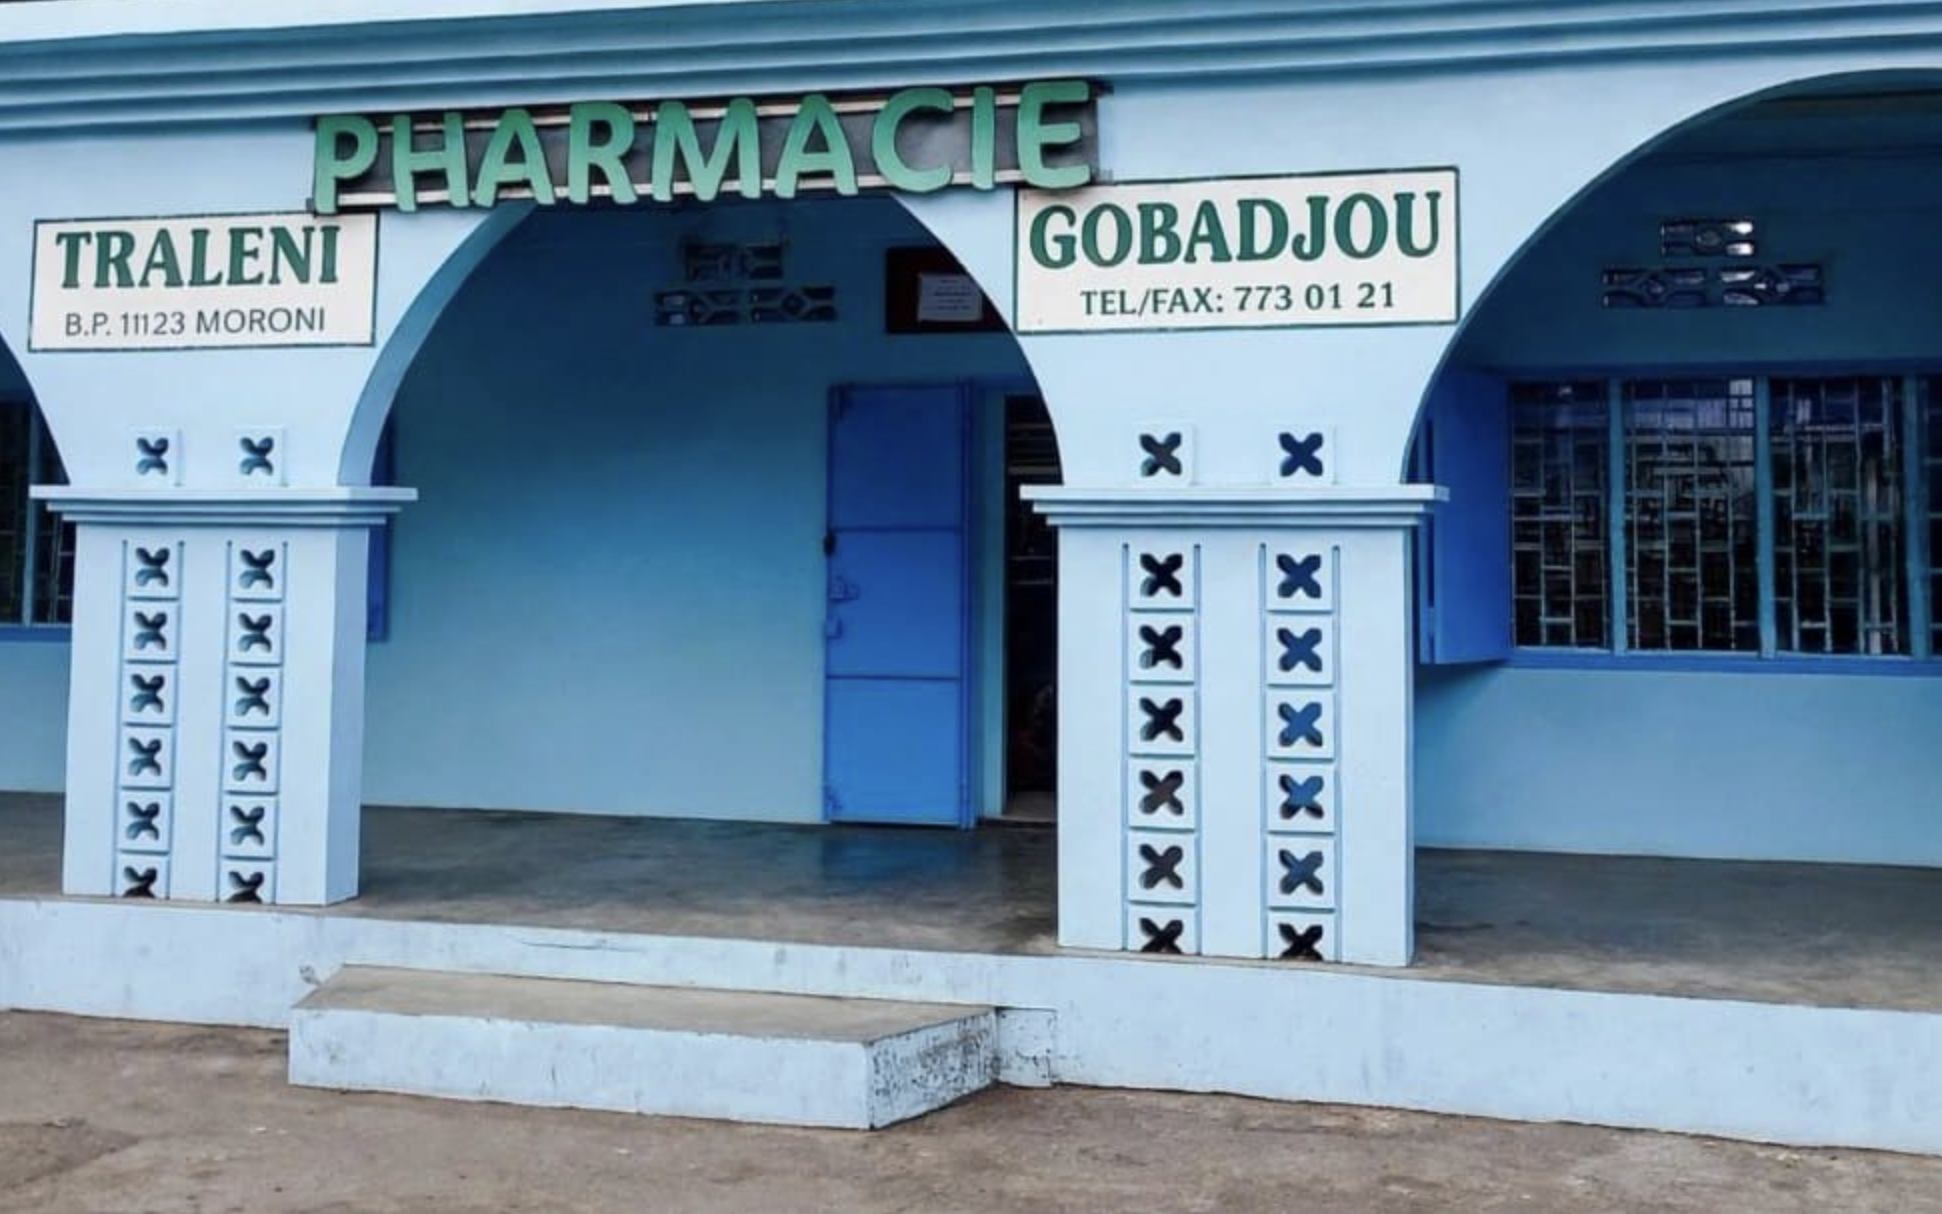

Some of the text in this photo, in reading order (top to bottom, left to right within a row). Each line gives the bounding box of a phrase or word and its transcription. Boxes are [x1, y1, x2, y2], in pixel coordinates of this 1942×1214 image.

[312, 80, 1092, 215] PHARMACIE
[55, 225, 341, 289] TRALENI
[1028, 190, 1441, 270] GOBADJOU
[64, 307, 326, 337] B.P. 11123 MORONI
[1079, 282, 1395, 317] TEL/FAX: 773 01 21
